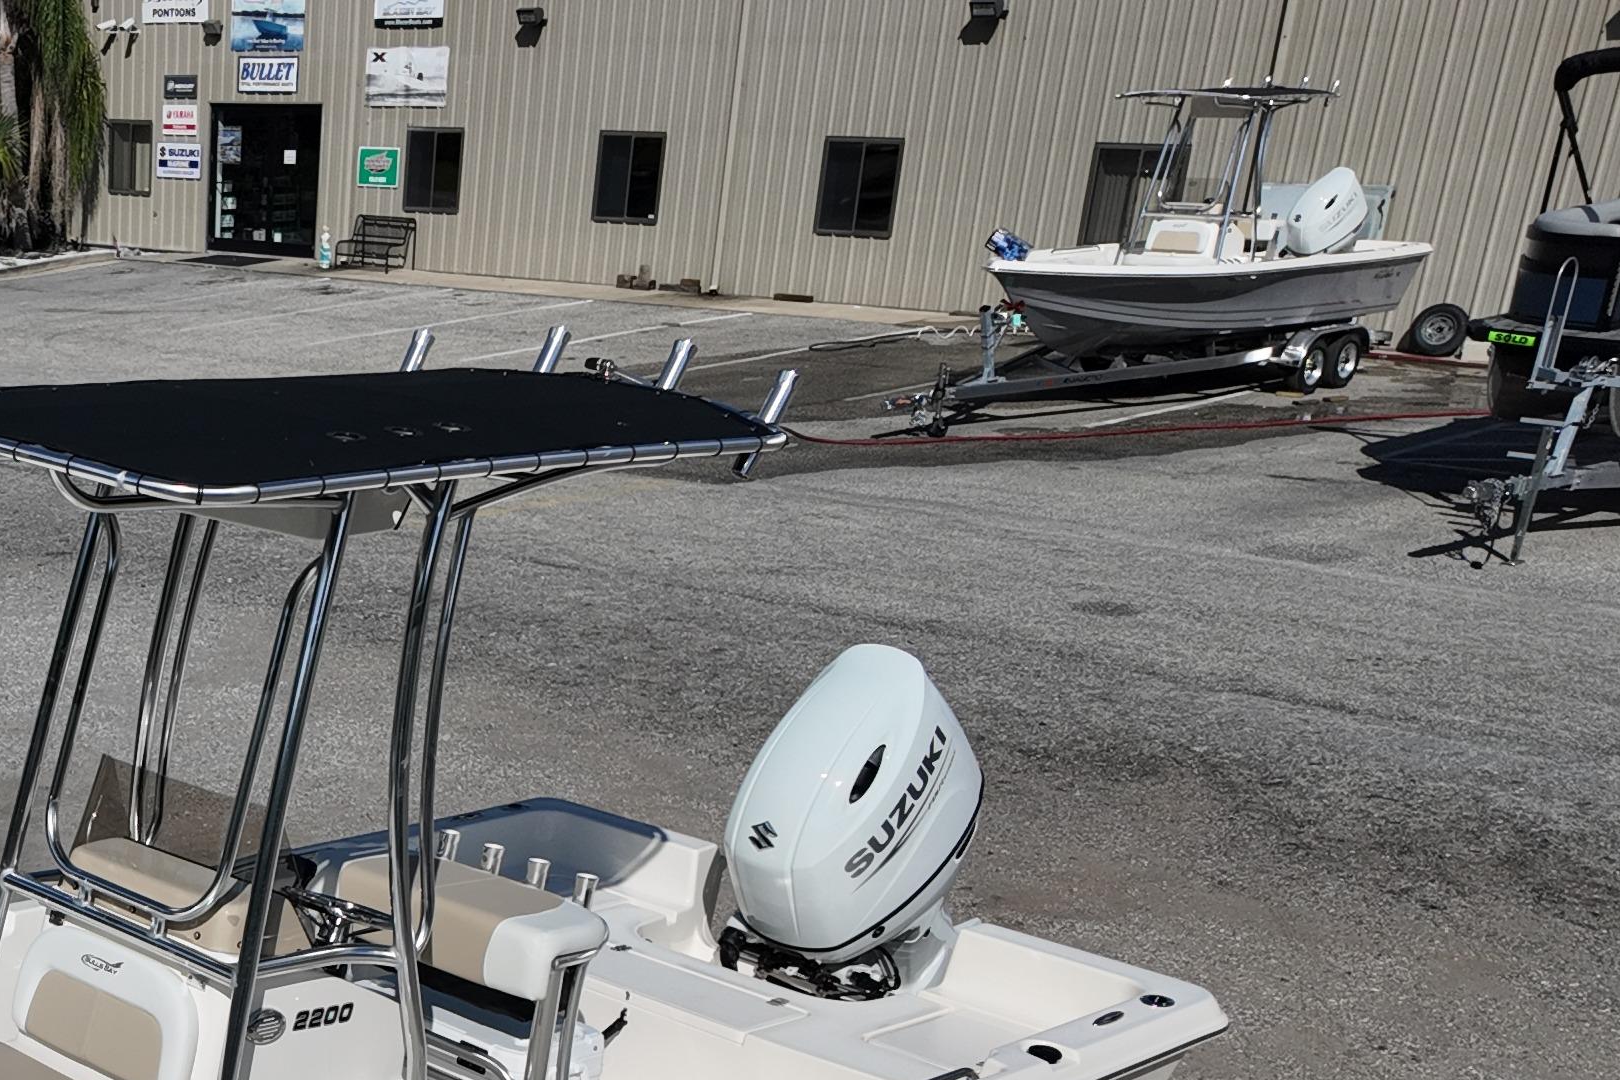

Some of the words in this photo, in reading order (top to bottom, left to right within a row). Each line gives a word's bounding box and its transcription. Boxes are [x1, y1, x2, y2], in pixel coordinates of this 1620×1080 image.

[152, 7, 196, 17] PONTOONS
[241, 62, 295, 80] BULLET
[173, 110, 194, 119] YAMAHA
[168, 148, 200, 157] SUZUKI
[1494, 333, 1529, 345] SOLD
[844, 725, 947, 878] SUZUKI
[292, 1002, 354, 1031] 2200
